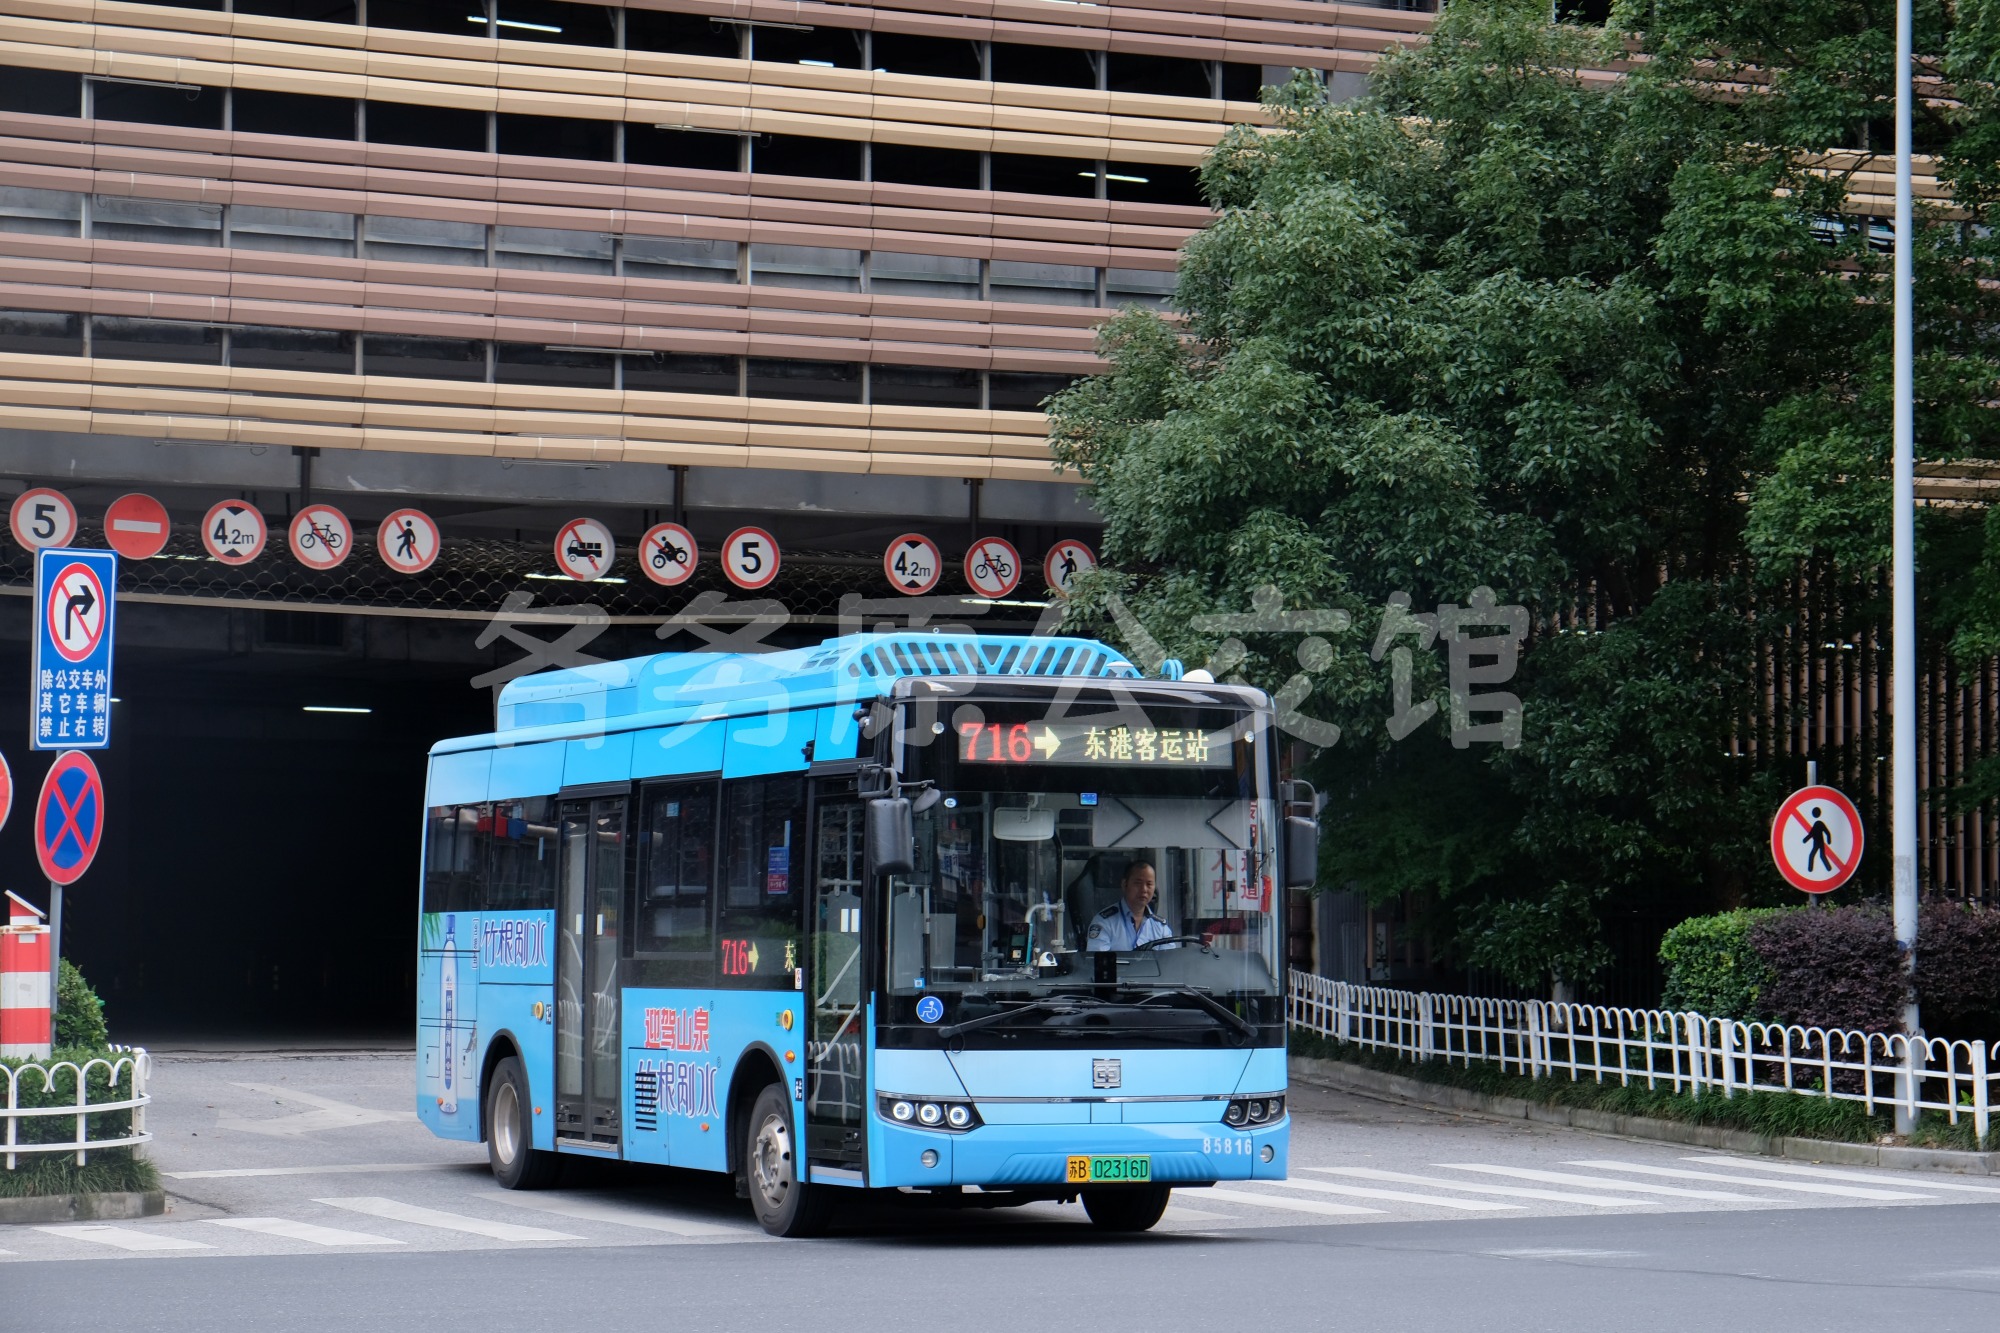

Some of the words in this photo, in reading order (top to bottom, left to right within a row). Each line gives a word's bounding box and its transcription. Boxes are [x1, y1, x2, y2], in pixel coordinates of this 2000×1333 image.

[32, 503, 56, 539] 5
[213, 518, 255, 545] 4.2m
[740, 541, 762, 574] 5
[894, 551, 931, 577] 4.2m
[41, 668, 107, 690] 除公交车外
[40, 691, 106, 714] 其它车辆
[40, 715, 105, 737] 禁止右转
[960, 722, 1032, 762] 716
[1083, 727, 1209, 762] 东港客运站
[722, 939, 748, 975] 716
[644, 1006, 710, 1053] 迎驾山泉
[1203, 1136, 1252, 1155] 85816
